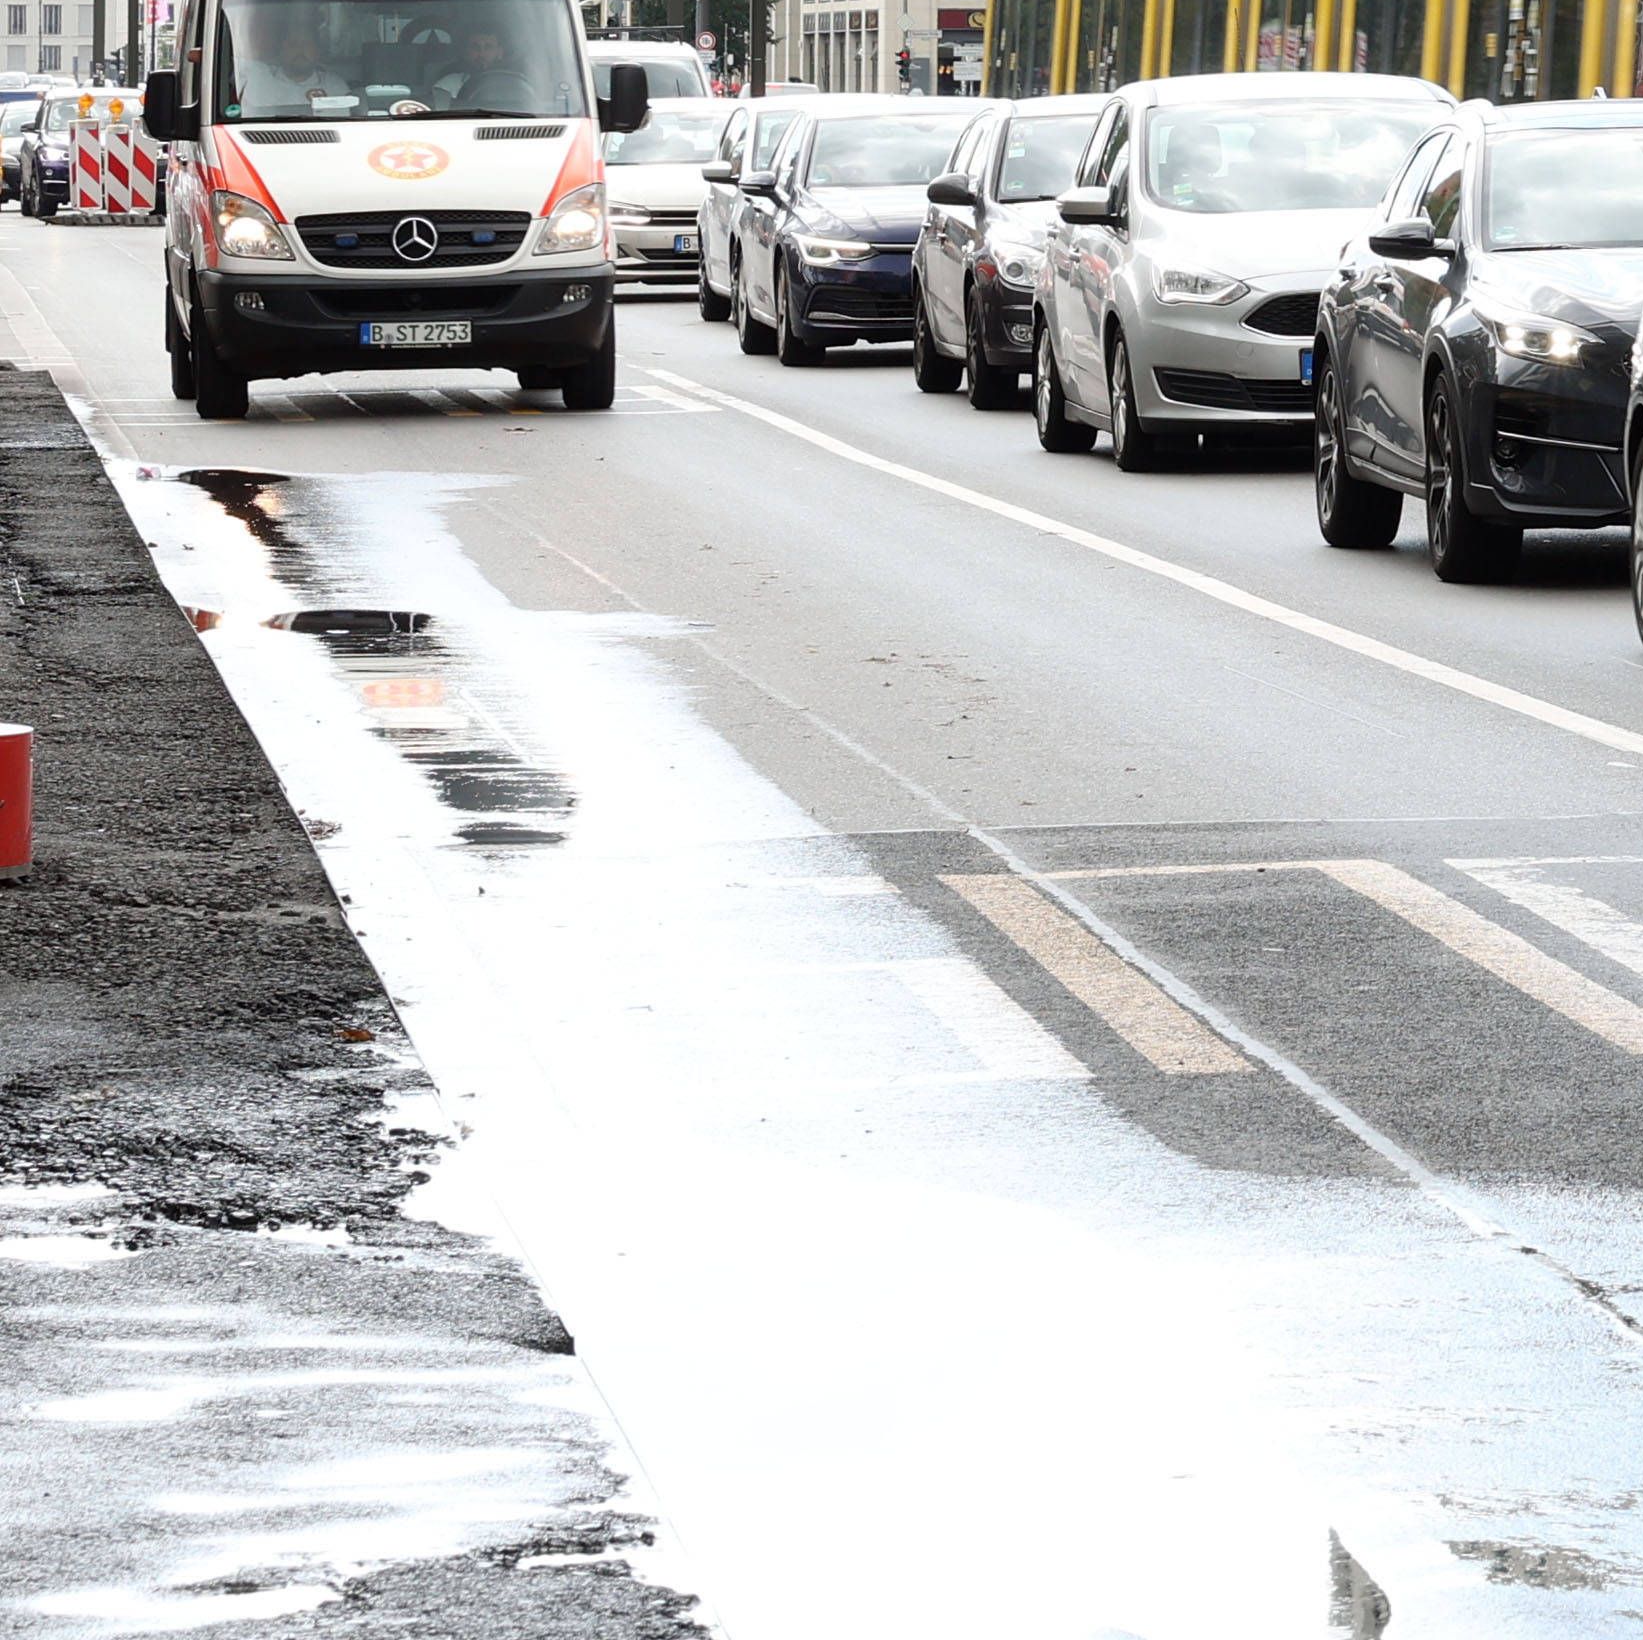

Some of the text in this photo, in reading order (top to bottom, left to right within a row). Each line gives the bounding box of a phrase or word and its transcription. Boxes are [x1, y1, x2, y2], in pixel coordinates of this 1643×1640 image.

[683, 237, 692, 249] B
[372, 323, 469, 342] B ST 2753
